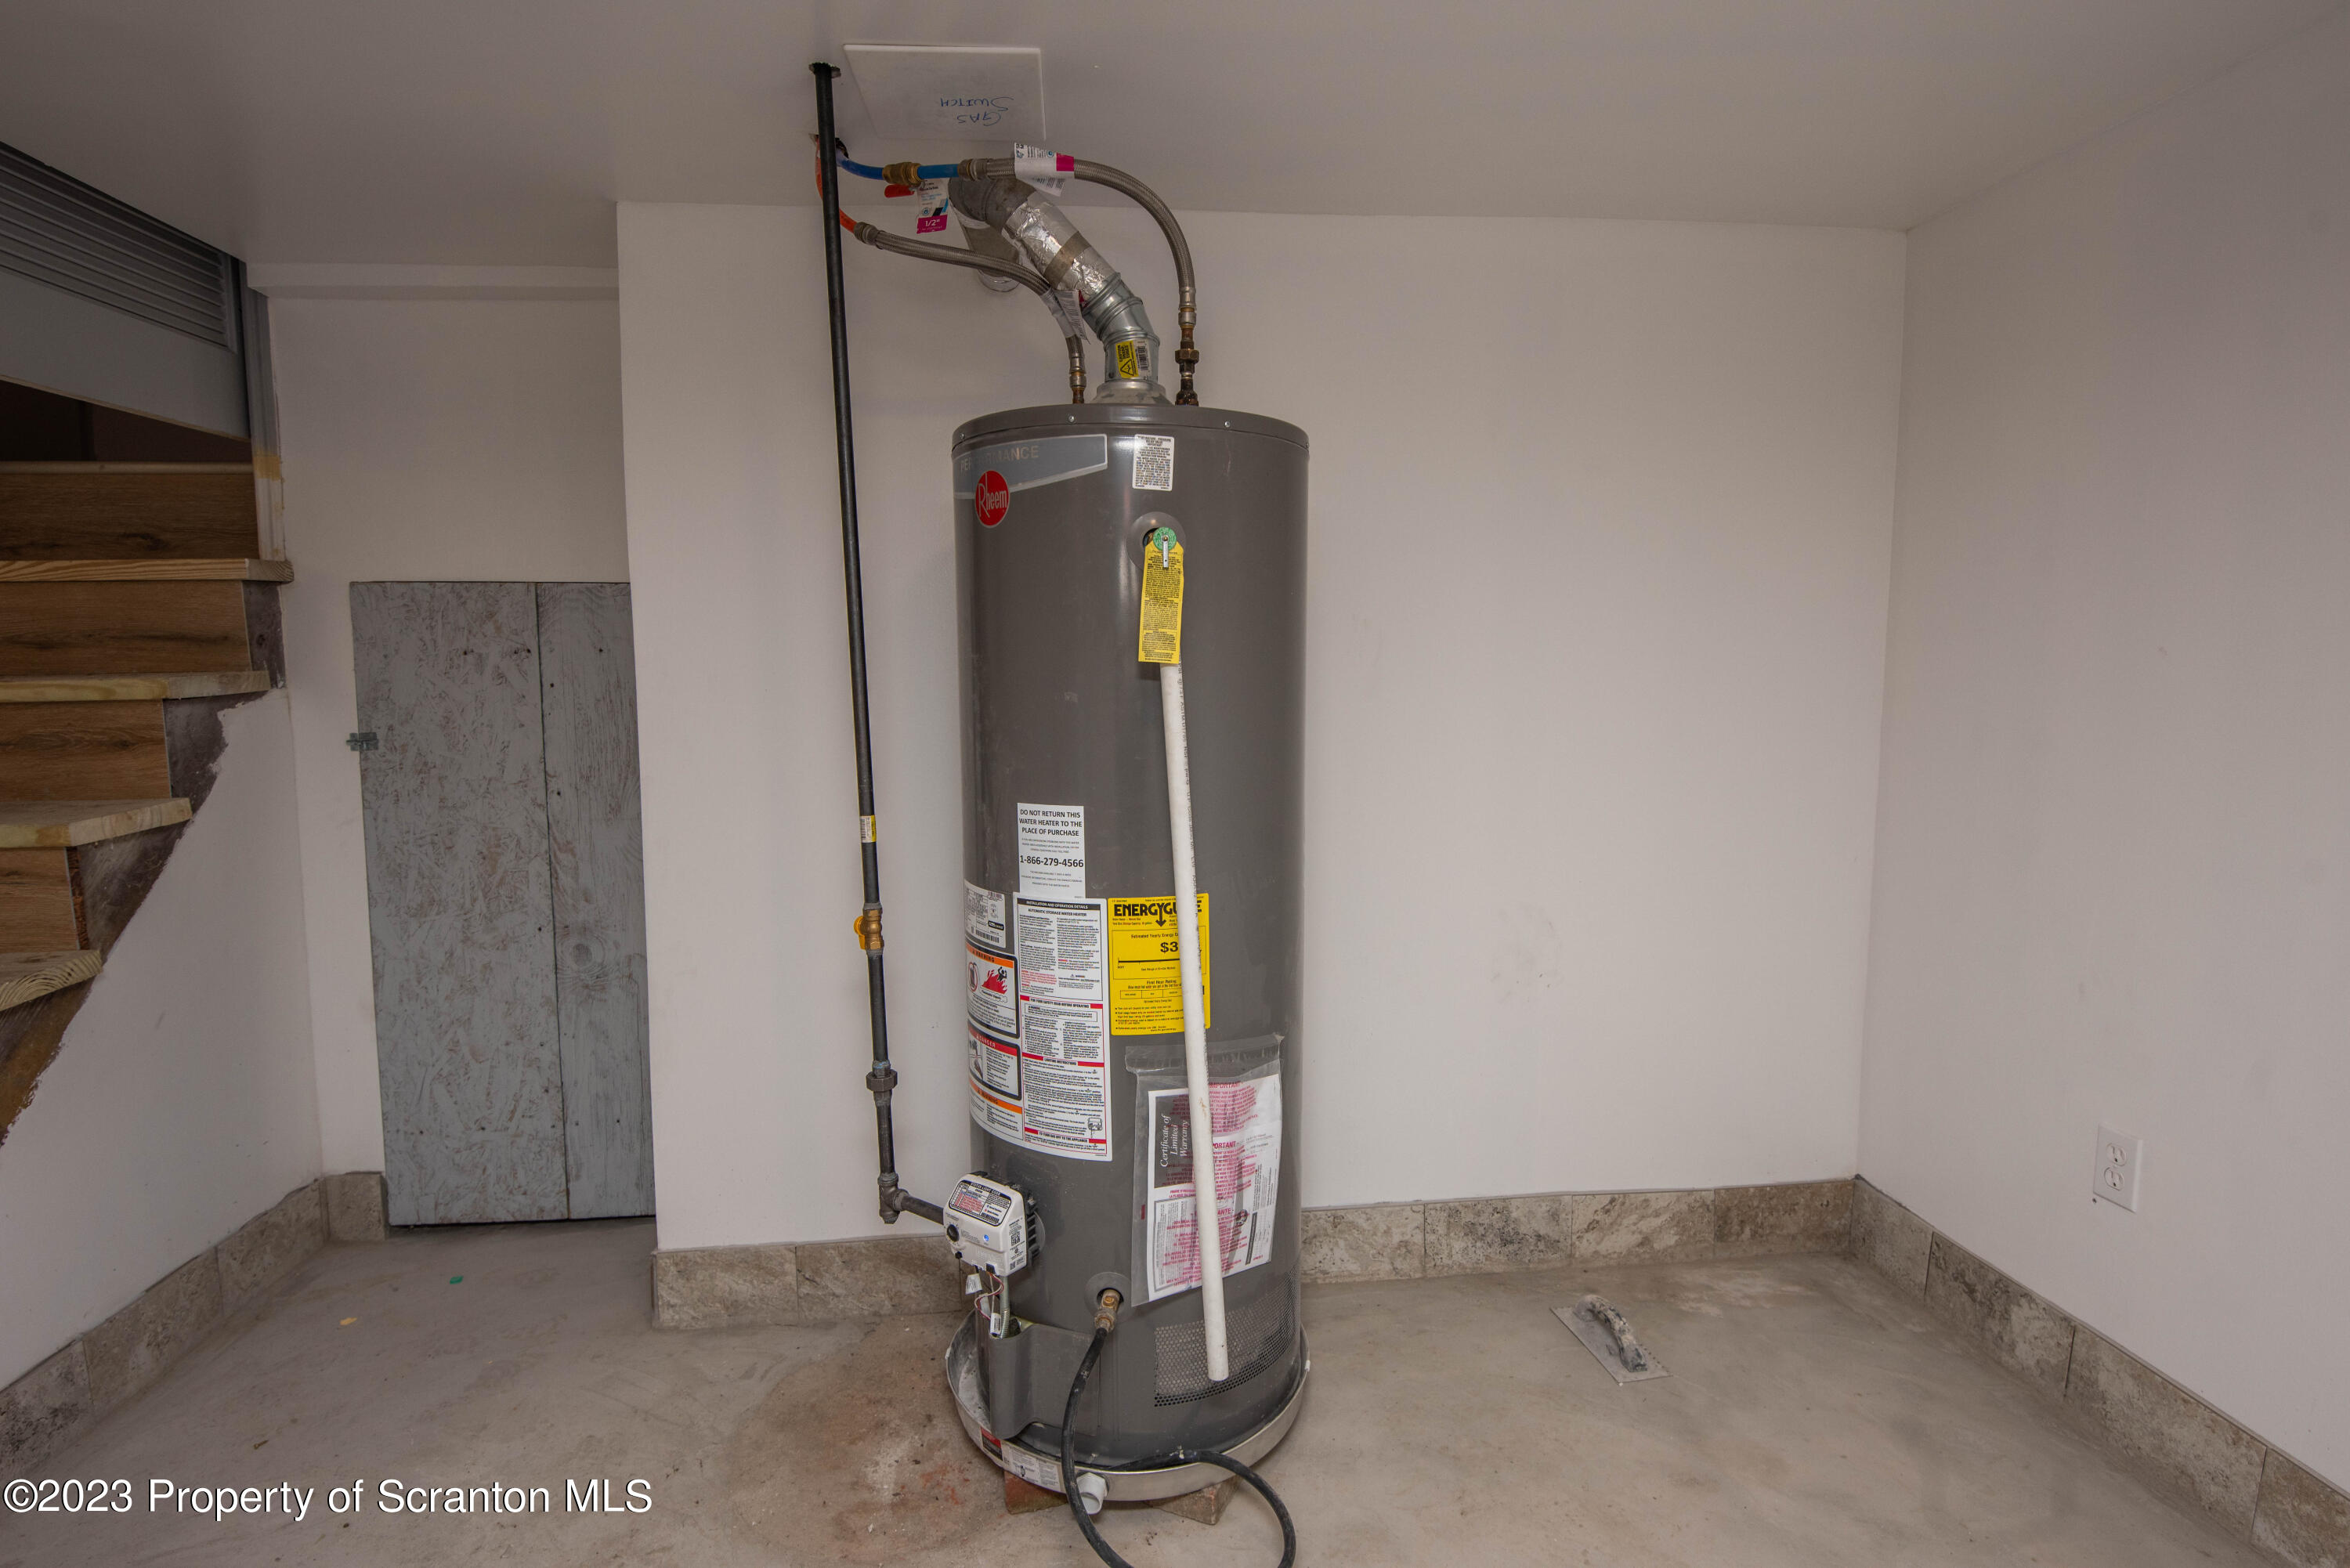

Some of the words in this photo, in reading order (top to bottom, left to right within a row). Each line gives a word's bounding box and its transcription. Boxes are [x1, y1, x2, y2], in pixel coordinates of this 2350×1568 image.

[956, 111, 1001, 126] GAS
[960, 445, 1039, 471] PERRMANCE
[978, 472, 1008, 518] Rheem
[1019, 854, 1084, 868] 1-866-279-4566
[979, 1037, 996, 1049] DANGER
[1161, 1114, 1172, 1124] of
[1160, 1125, 1170, 1168] Certificate
[1170, 1124, 1179, 1155] Limited
[1180, 1120, 1190, 1157] Warranty
